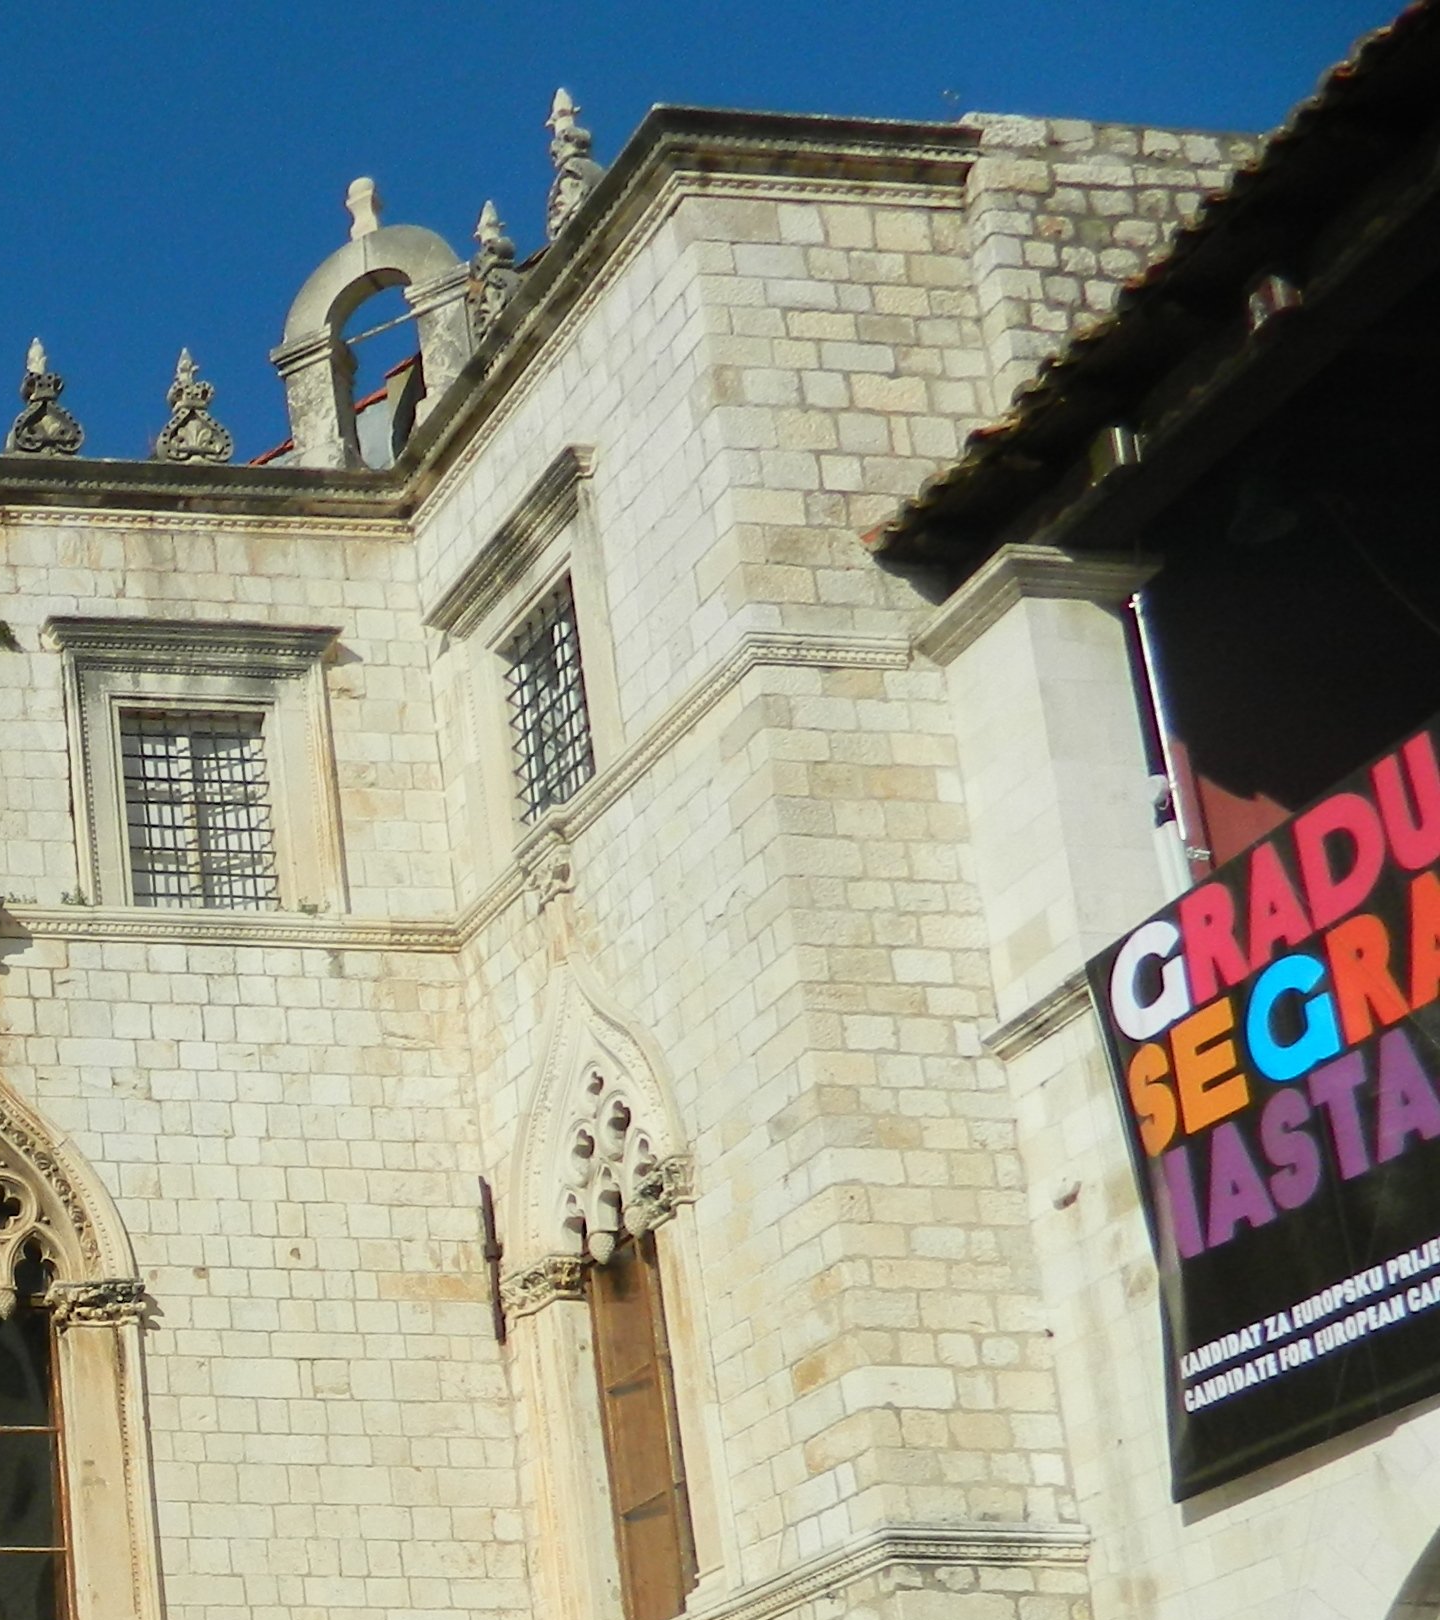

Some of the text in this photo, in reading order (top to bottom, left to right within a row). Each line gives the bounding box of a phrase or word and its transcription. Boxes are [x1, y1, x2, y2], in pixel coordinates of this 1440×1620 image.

[1180, 1323, 1263, 1379] KANDIDAT
[1264, 1311, 1292, 1342] ZA
[1292, 1266, 1385, 1328] EUROPSKU
[1184, 1353, 1278, 1412] CANDIDATE
[1279, 1337, 1313, 1371] FOR
[1313, 1294, 1405, 1355] EUROPEAN
